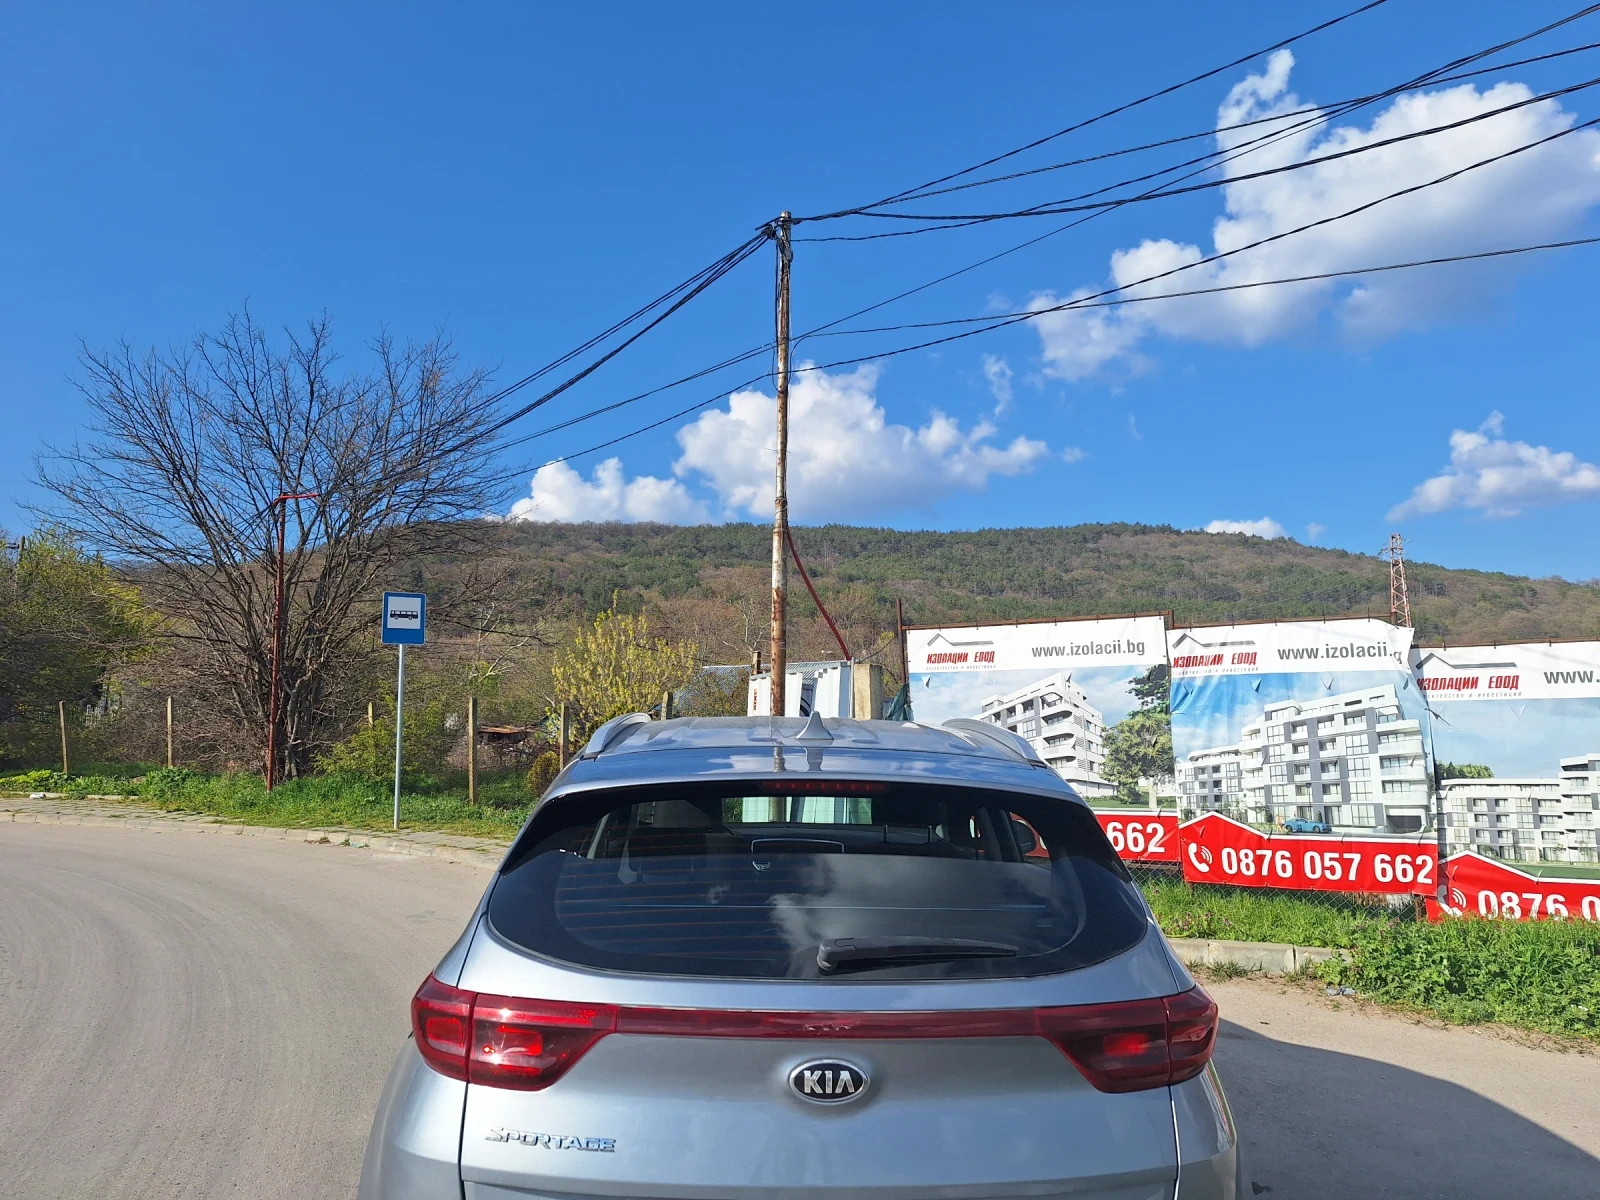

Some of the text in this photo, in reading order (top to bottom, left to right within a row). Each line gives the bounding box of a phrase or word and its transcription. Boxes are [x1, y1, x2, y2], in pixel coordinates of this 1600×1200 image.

[926, 650, 995, 664] ИЗОЛАЦИИ ЕООД
[1031, 639, 1145, 657] www.izolacii.bg
[1172, 652, 1258, 668] ИЗОЛАЦИИ ЕООД
[1488, 675, 1520, 690] ЕООД
[1106, 821, 1165, 853] 662
[1221, 847, 1433, 884] 0876 057 662
[1477, 890, 1569, 921] 0876
[803, 1070, 855, 1094] KIA
[485, 1127, 616, 1153] SPORTAGE
